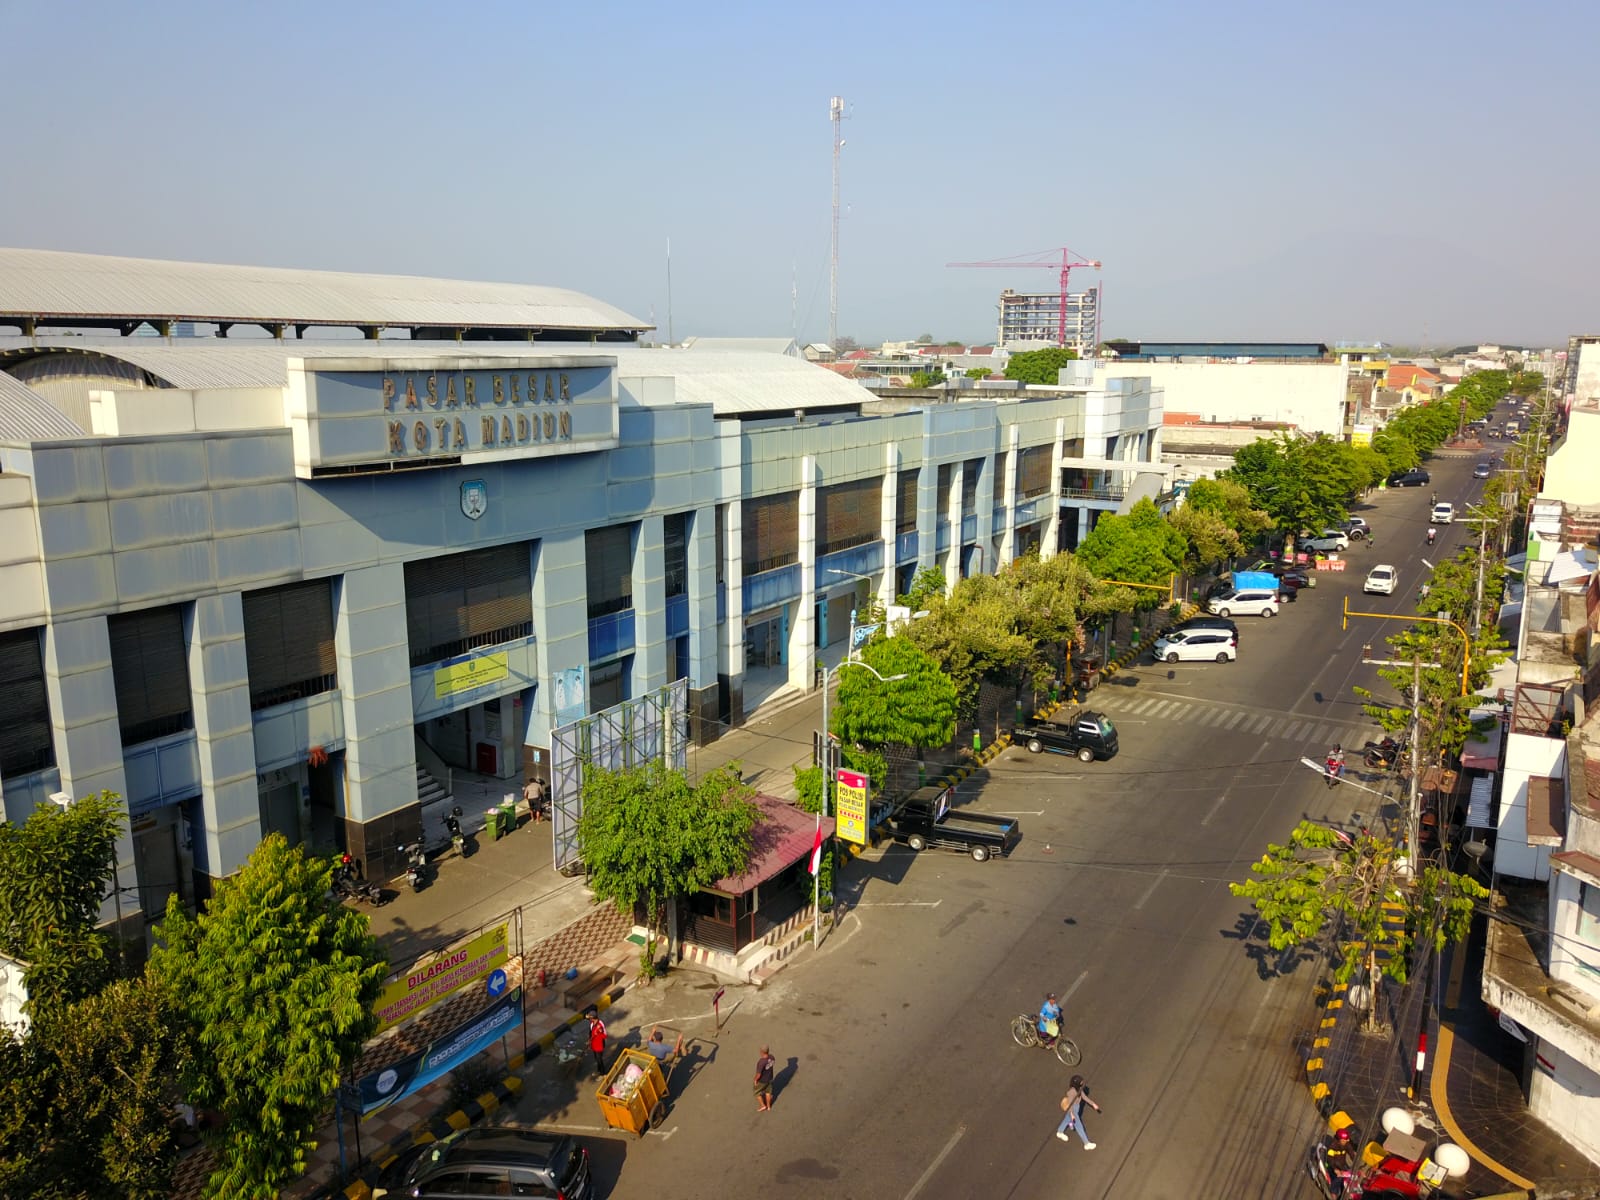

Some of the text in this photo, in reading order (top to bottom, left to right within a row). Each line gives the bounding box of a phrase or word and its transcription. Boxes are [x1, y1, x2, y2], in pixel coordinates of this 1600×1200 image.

[383, 373, 570, 410] PASAR BESAR
[388, 411, 572, 453] KOTA MADIUN
[407, 950, 468, 990] DILARANG
